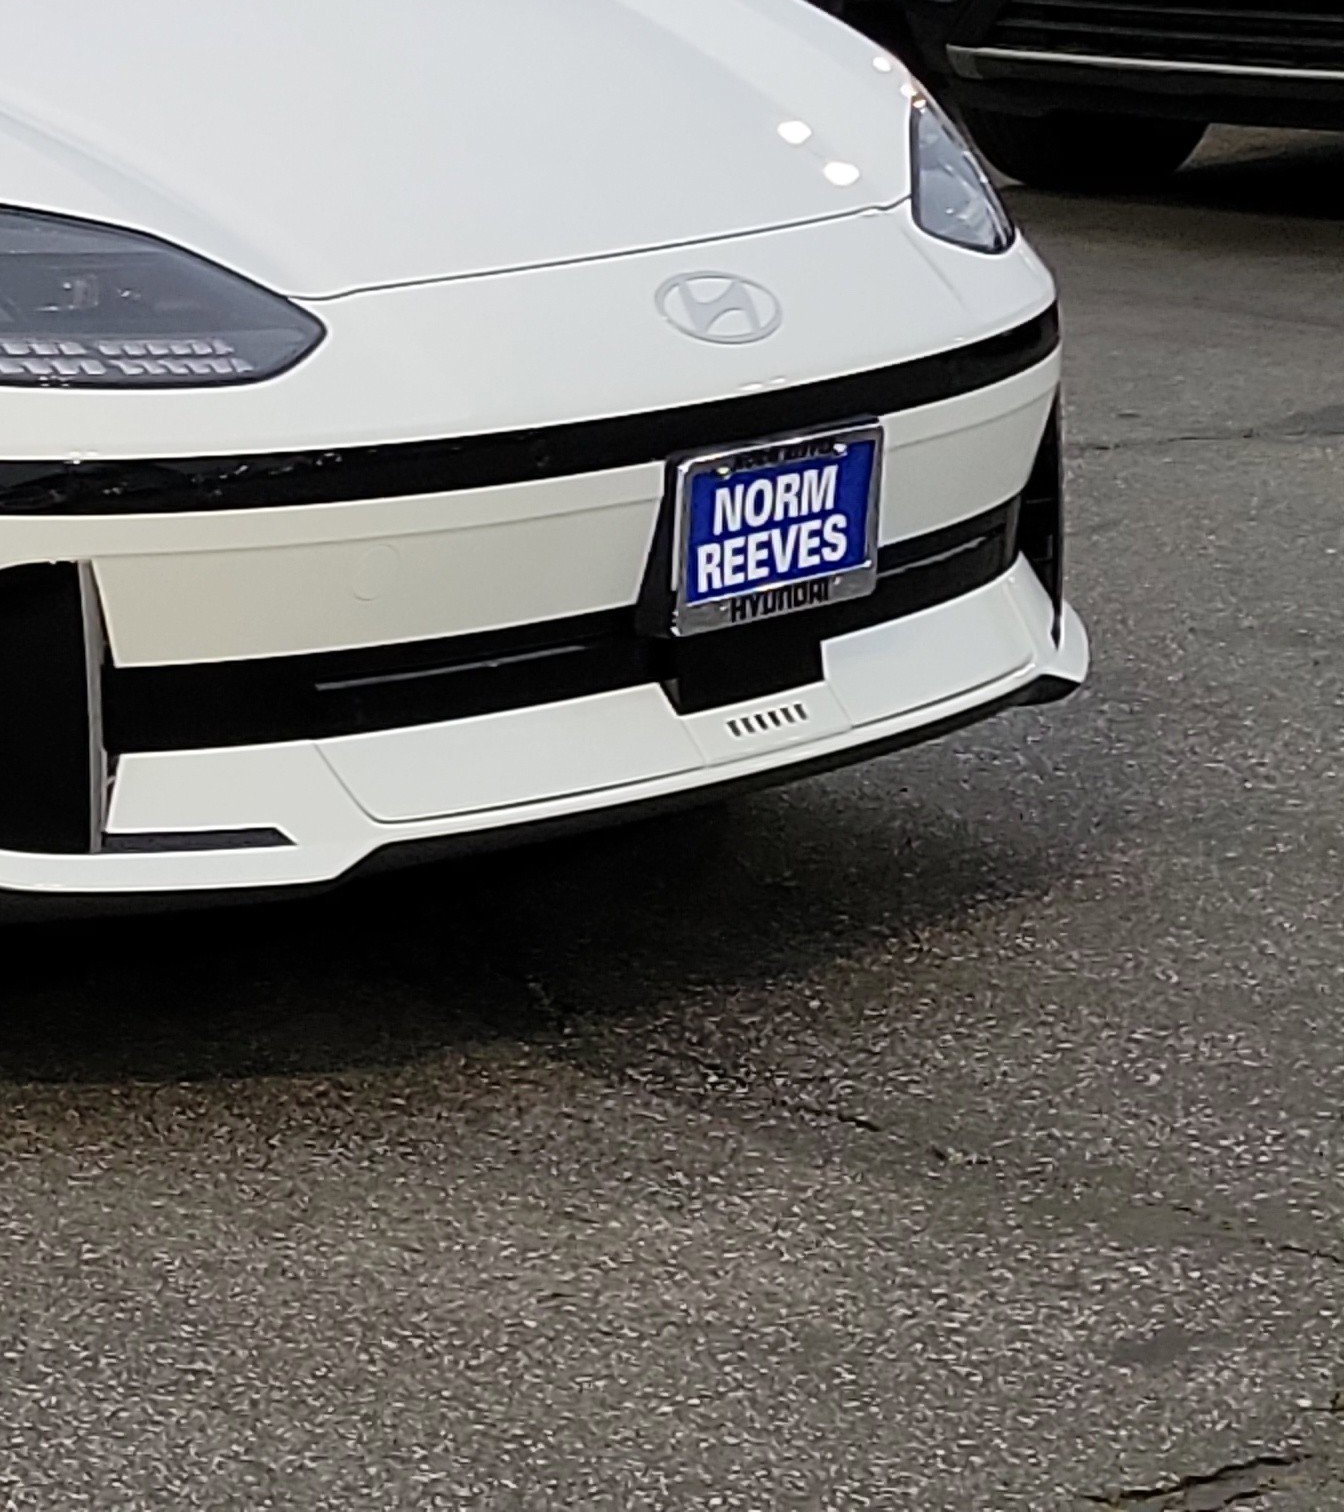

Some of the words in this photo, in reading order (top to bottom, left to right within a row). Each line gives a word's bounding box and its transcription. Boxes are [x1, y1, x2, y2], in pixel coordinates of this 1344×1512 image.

[713, 464, 839, 536] NORM
[697, 513, 847, 593] REEVES
[730, 580, 830, 624] HYUNDAI
